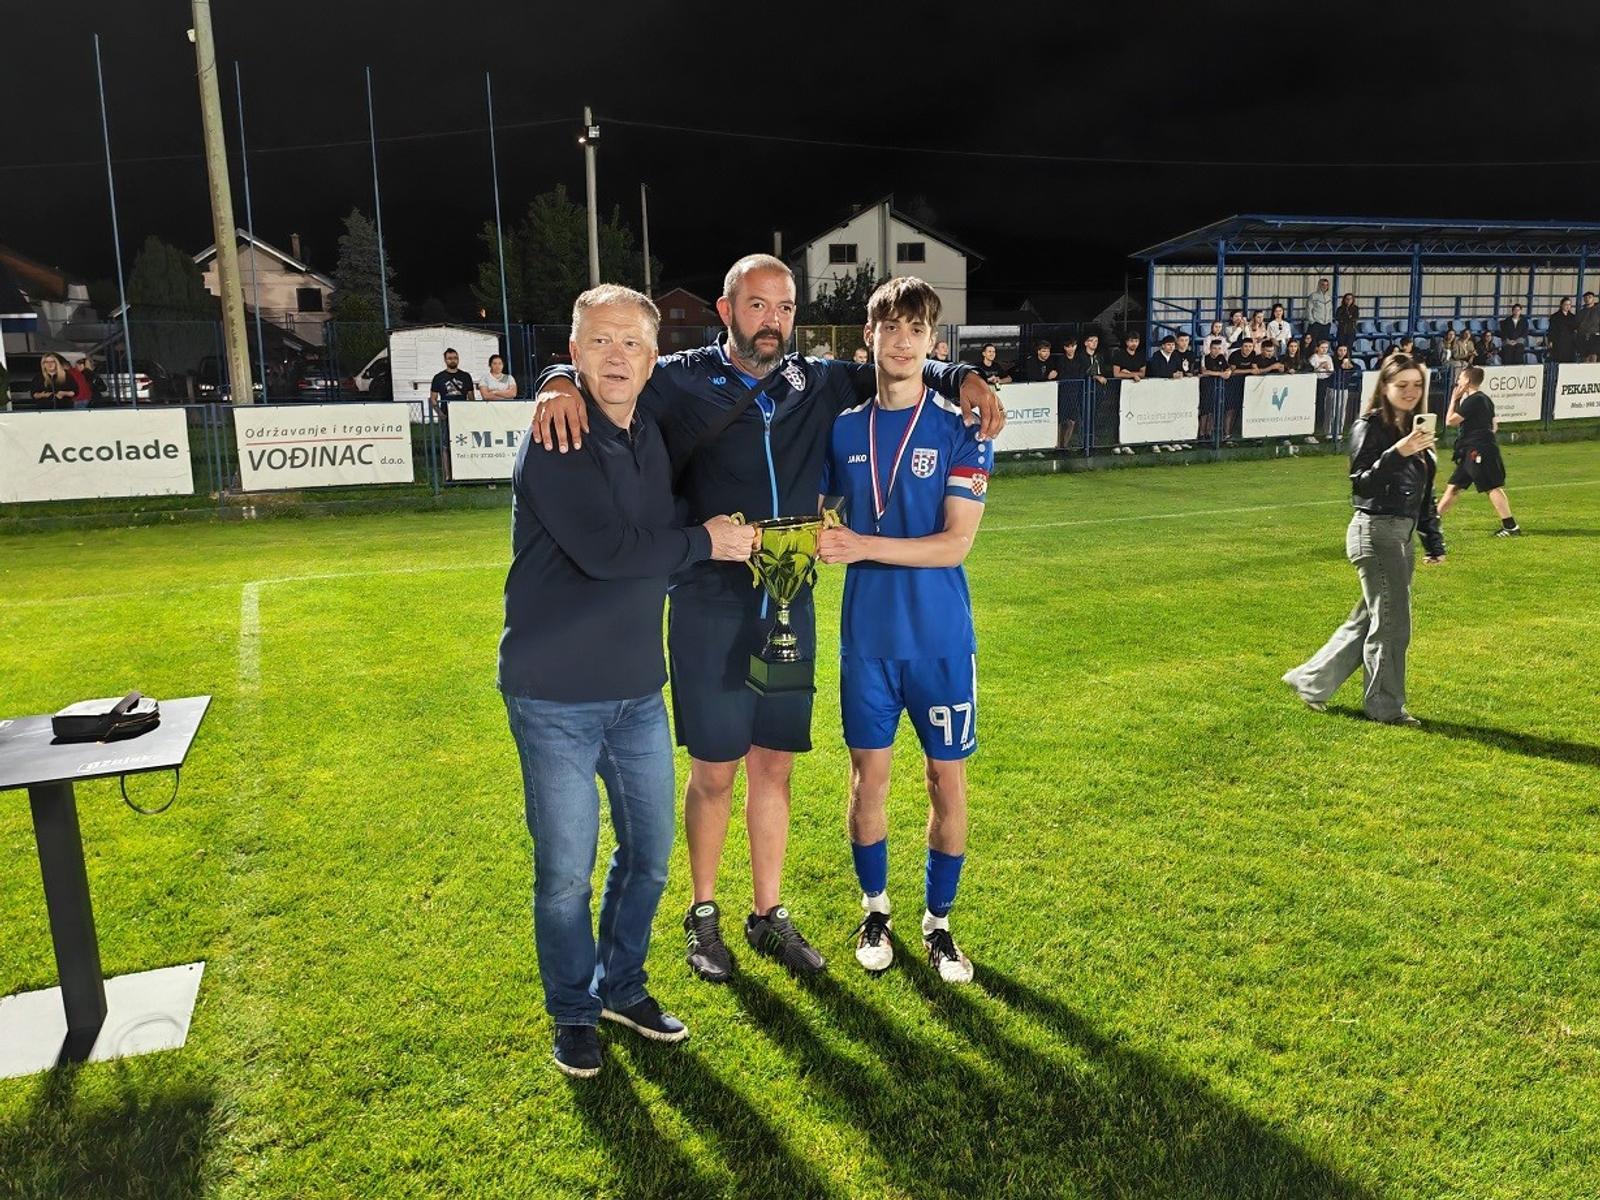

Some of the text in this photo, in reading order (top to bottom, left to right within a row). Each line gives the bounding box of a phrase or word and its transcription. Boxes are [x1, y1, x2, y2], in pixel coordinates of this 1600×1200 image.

[1489, 375, 1538, 391] GEOVID
[1006, 407, 1051, 420] ONTER
[245, 424, 328, 438] Održavanje
[343, 423, 403, 436] trgovina
[38, 439, 179, 464] Accolade
[248, 443, 406, 472] VOĐINAC d.o.o.
[847, 454, 867, 464] JAKO
[928, 702, 972, 746] 97
